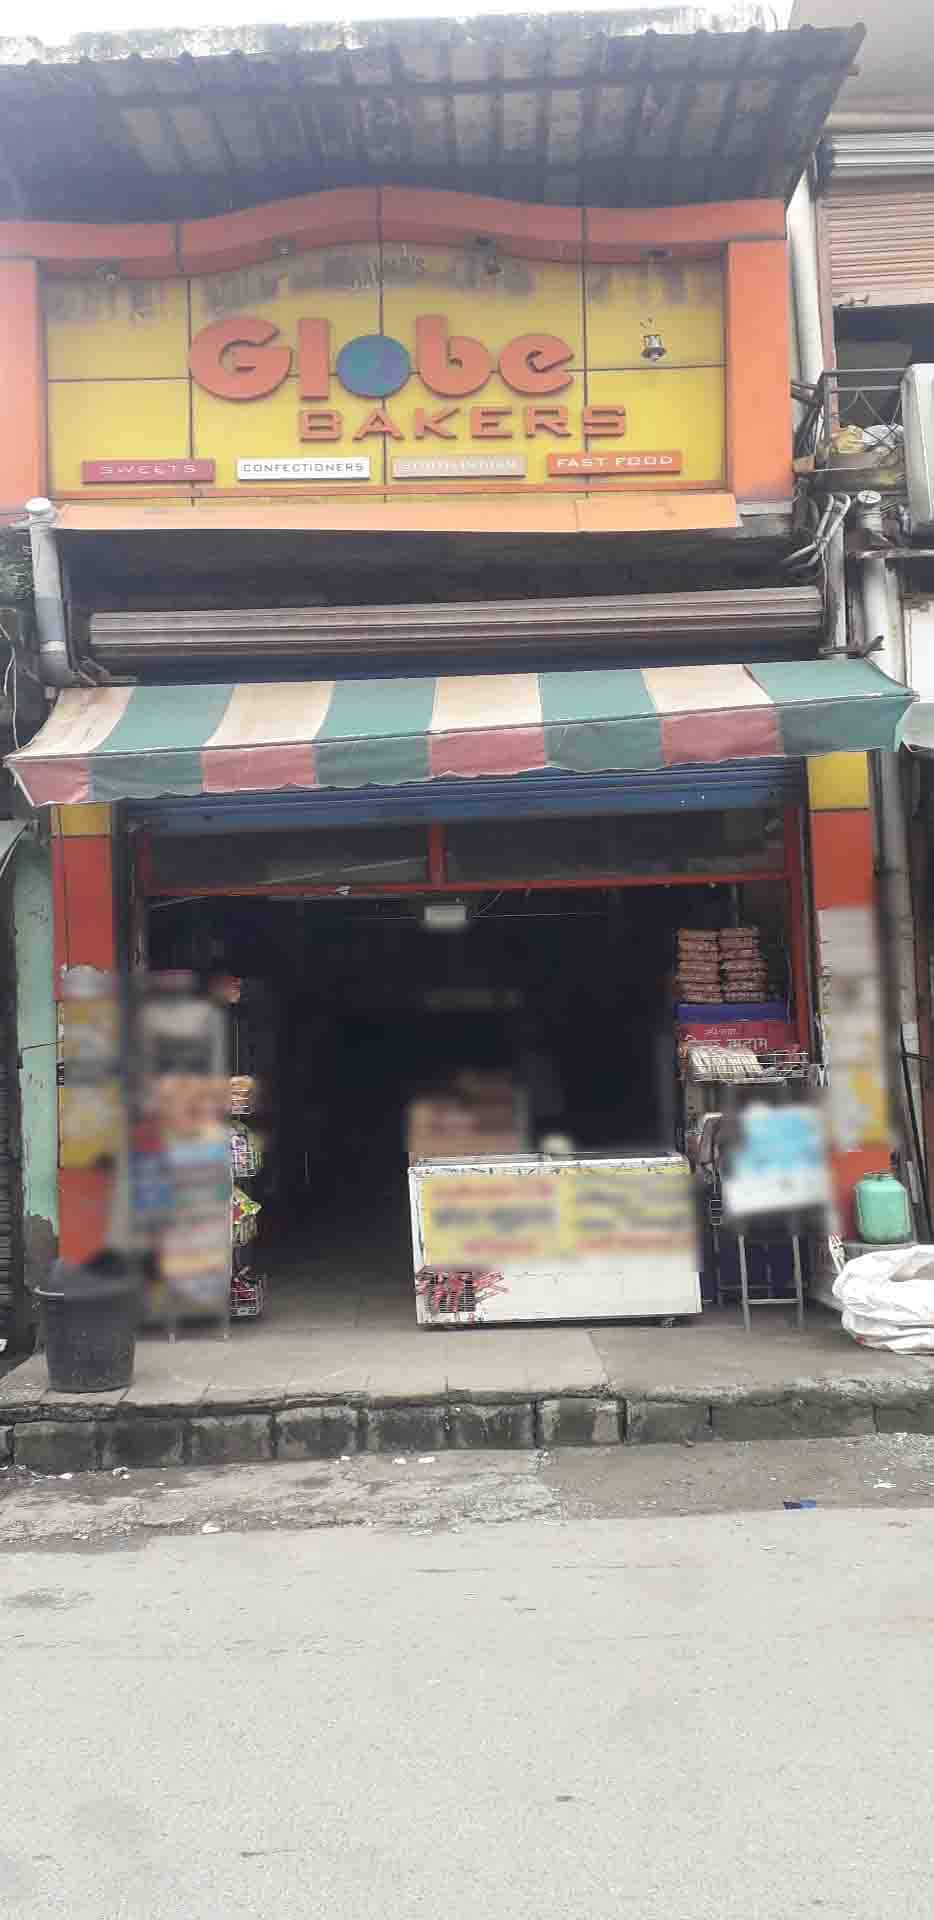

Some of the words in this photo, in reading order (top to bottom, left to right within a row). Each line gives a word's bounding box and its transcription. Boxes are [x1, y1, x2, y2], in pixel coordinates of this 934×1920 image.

[188, 313, 576, 402] Globe
[299, 404, 627, 443] BAKERS
[99, 463, 198, 475] SWEETS
[239, 462, 365, 473] CONFECTIONERS
[556, 456, 609, 469] FAST
[615, 454, 674, 467] FOOD
